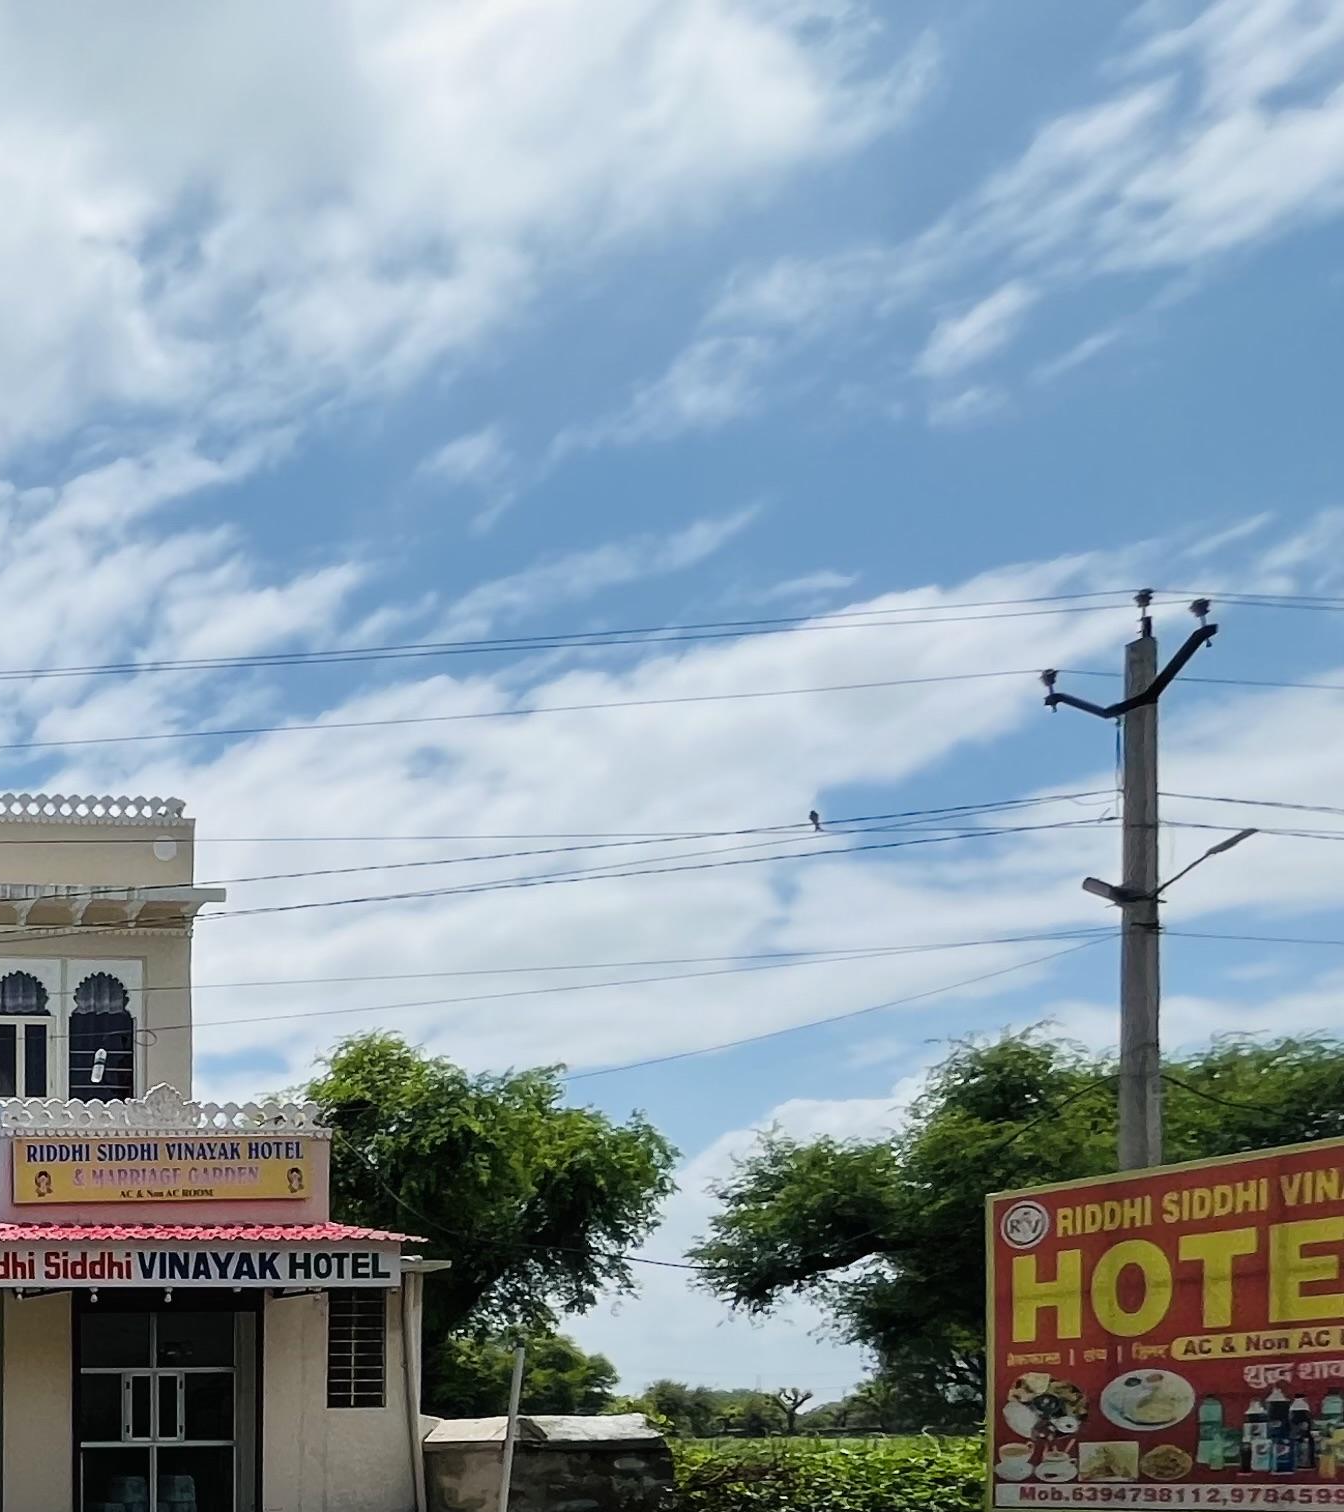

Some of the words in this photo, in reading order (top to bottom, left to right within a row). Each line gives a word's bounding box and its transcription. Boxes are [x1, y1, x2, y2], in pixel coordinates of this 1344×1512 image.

[27, 1143, 91, 1162] RIDDHI
[97, 1142, 159, 1161] SIDDHI
[166, 1141, 241, 1161] VINAYAK
[248, 1141, 304, 1160] HOTEL
[72, 1168, 84, 1186] &
[187, 1166, 260, 1184] GARDEN
[119, 1190, 134, 1198] AC
[1056, 1195, 1152, 1237] RIDDHI
[1162, 1178, 1267, 1223] SIDDHI
[1280, 1167, 1344, 1206] VIN
[44, 1251, 132, 1280] Siddhi
[137, 1251, 282, 1280] VINAYAK
[288, 1250, 391, 1280] HOTEL
[1183, 1339, 1213, 1356] AC
[1221, 1336, 1236, 1353] &
[1245, 1334, 1289, 1352] Non
[1298, 1330, 1330, 1348] AC
